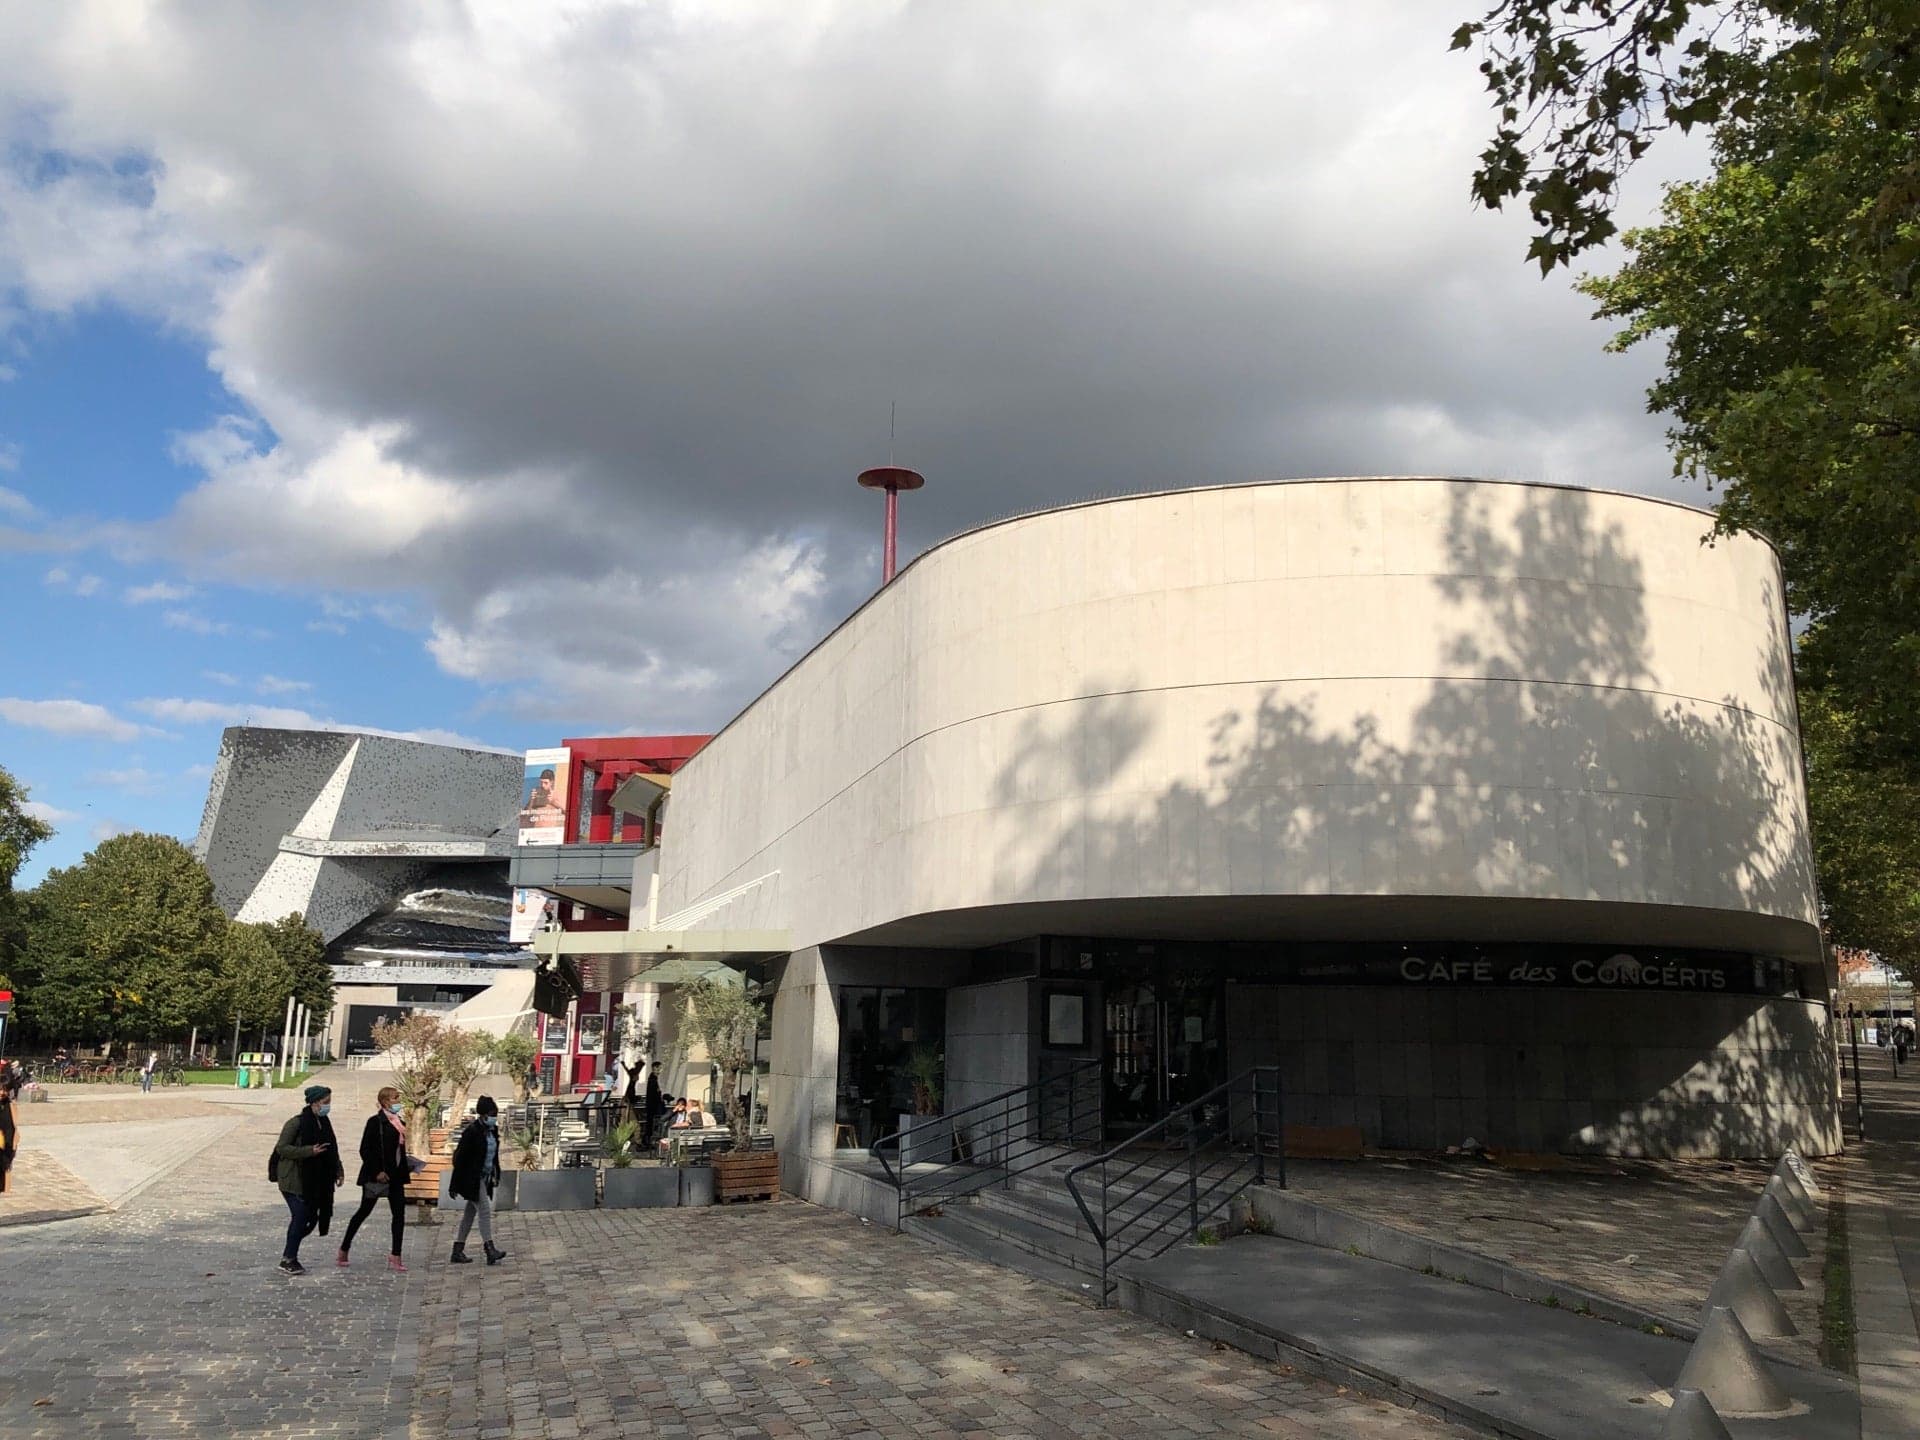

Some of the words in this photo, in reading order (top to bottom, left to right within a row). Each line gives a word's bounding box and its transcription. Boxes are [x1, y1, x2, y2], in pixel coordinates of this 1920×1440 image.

[1400, 956, 1494, 983] CAFÉ
[1509, 961, 1557, 982] des
[1571, 959, 1727, 989] CONCERTS
